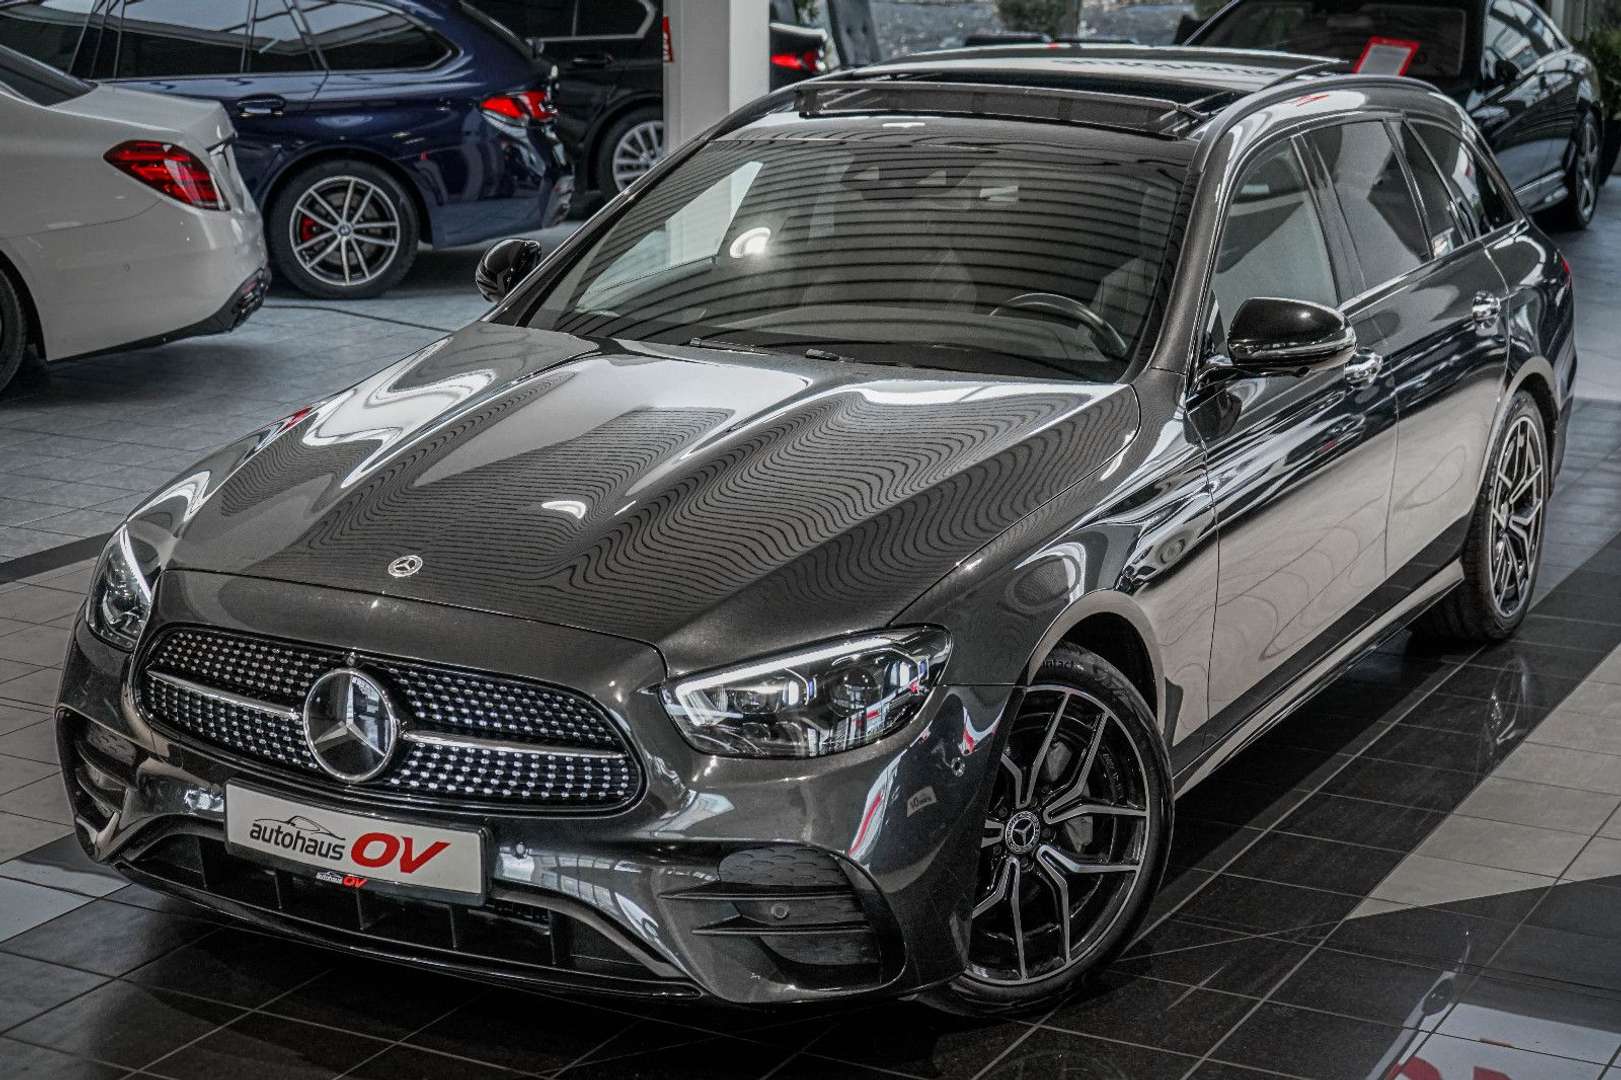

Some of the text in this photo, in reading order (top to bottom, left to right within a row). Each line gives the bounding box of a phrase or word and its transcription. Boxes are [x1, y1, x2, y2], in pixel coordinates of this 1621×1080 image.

[250, 824, 451, 873] autohaus OV
[343, 876, 368, 888] OV
